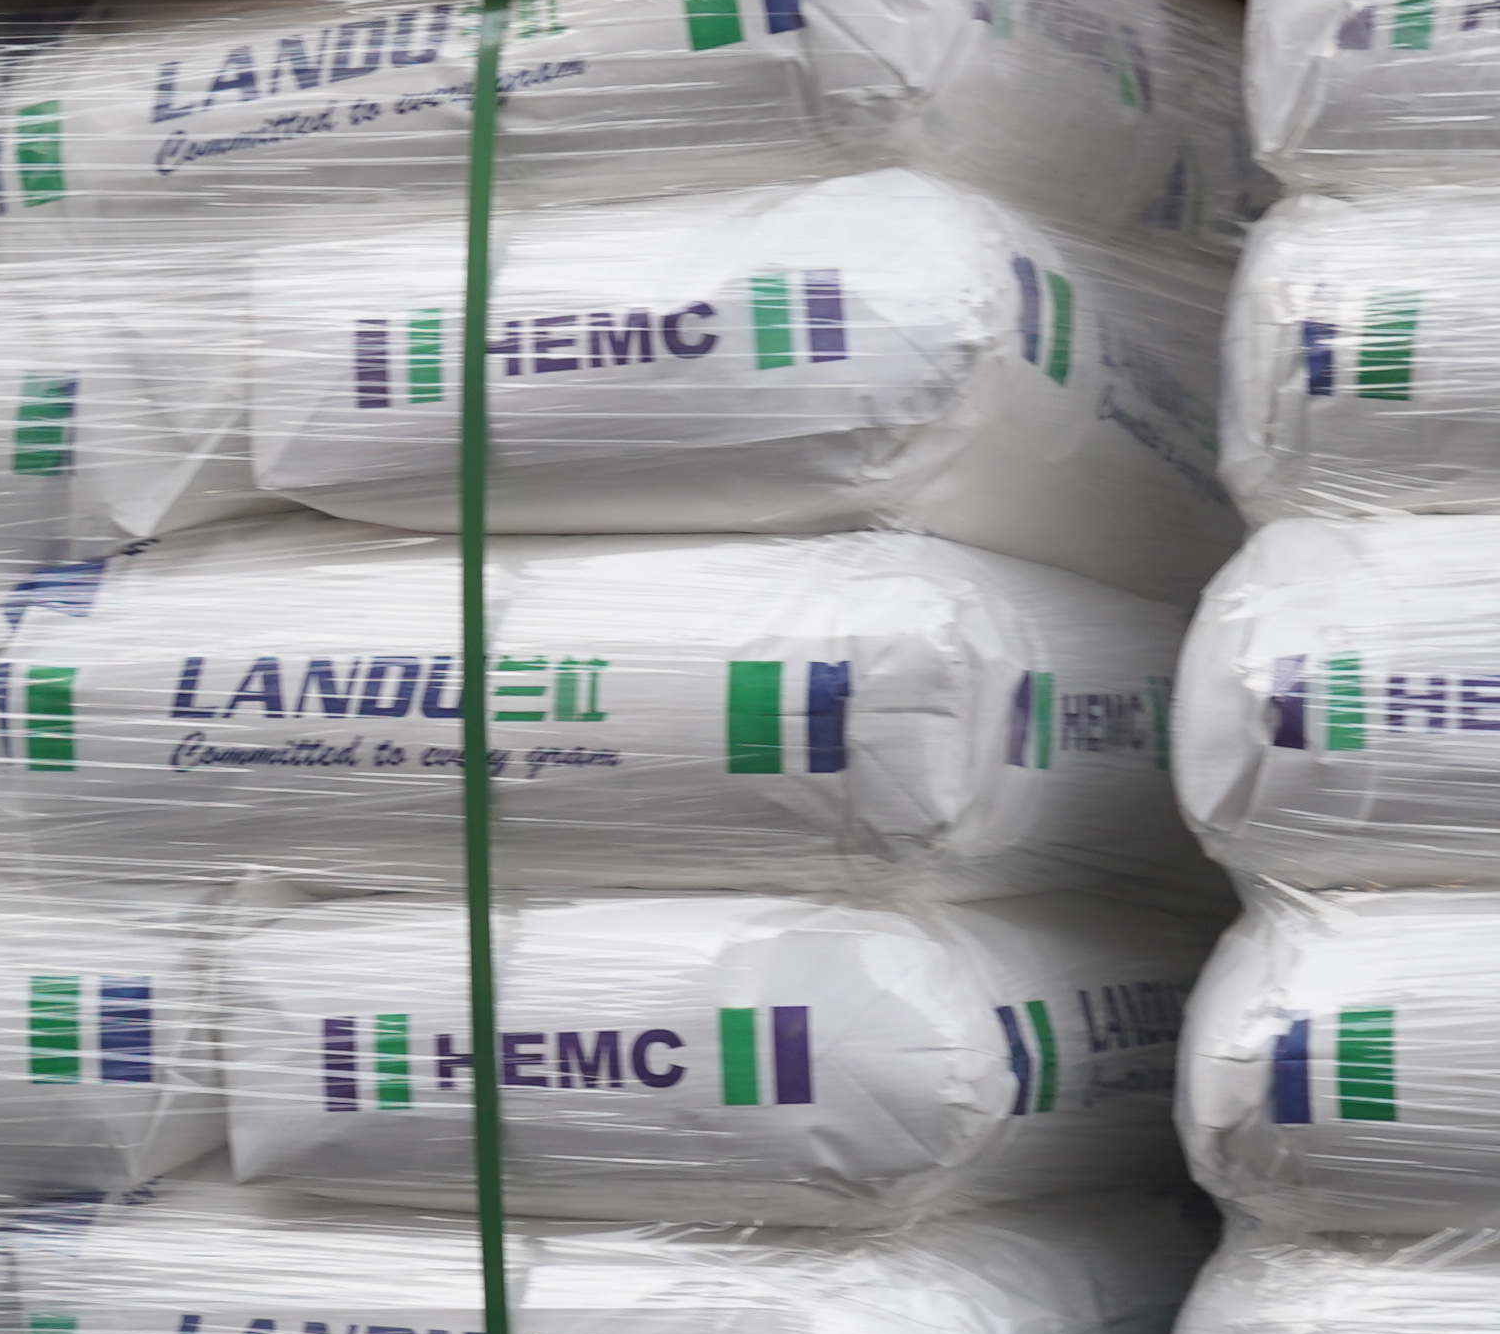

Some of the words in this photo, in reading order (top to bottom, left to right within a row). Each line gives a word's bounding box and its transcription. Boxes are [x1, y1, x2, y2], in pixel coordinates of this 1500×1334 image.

[150, 3, 453, 124] LANDU
[155, 99, 338, 176] Committed
[348, 97, 382, 126] to
[169, 655, 483, 720] LANDU
[169, 729, 361, 773] Committed
[372, 739, 406, 769] to
[420, 746, 512, 777] evey
[433, 1028, 688, 1093] HEMC
